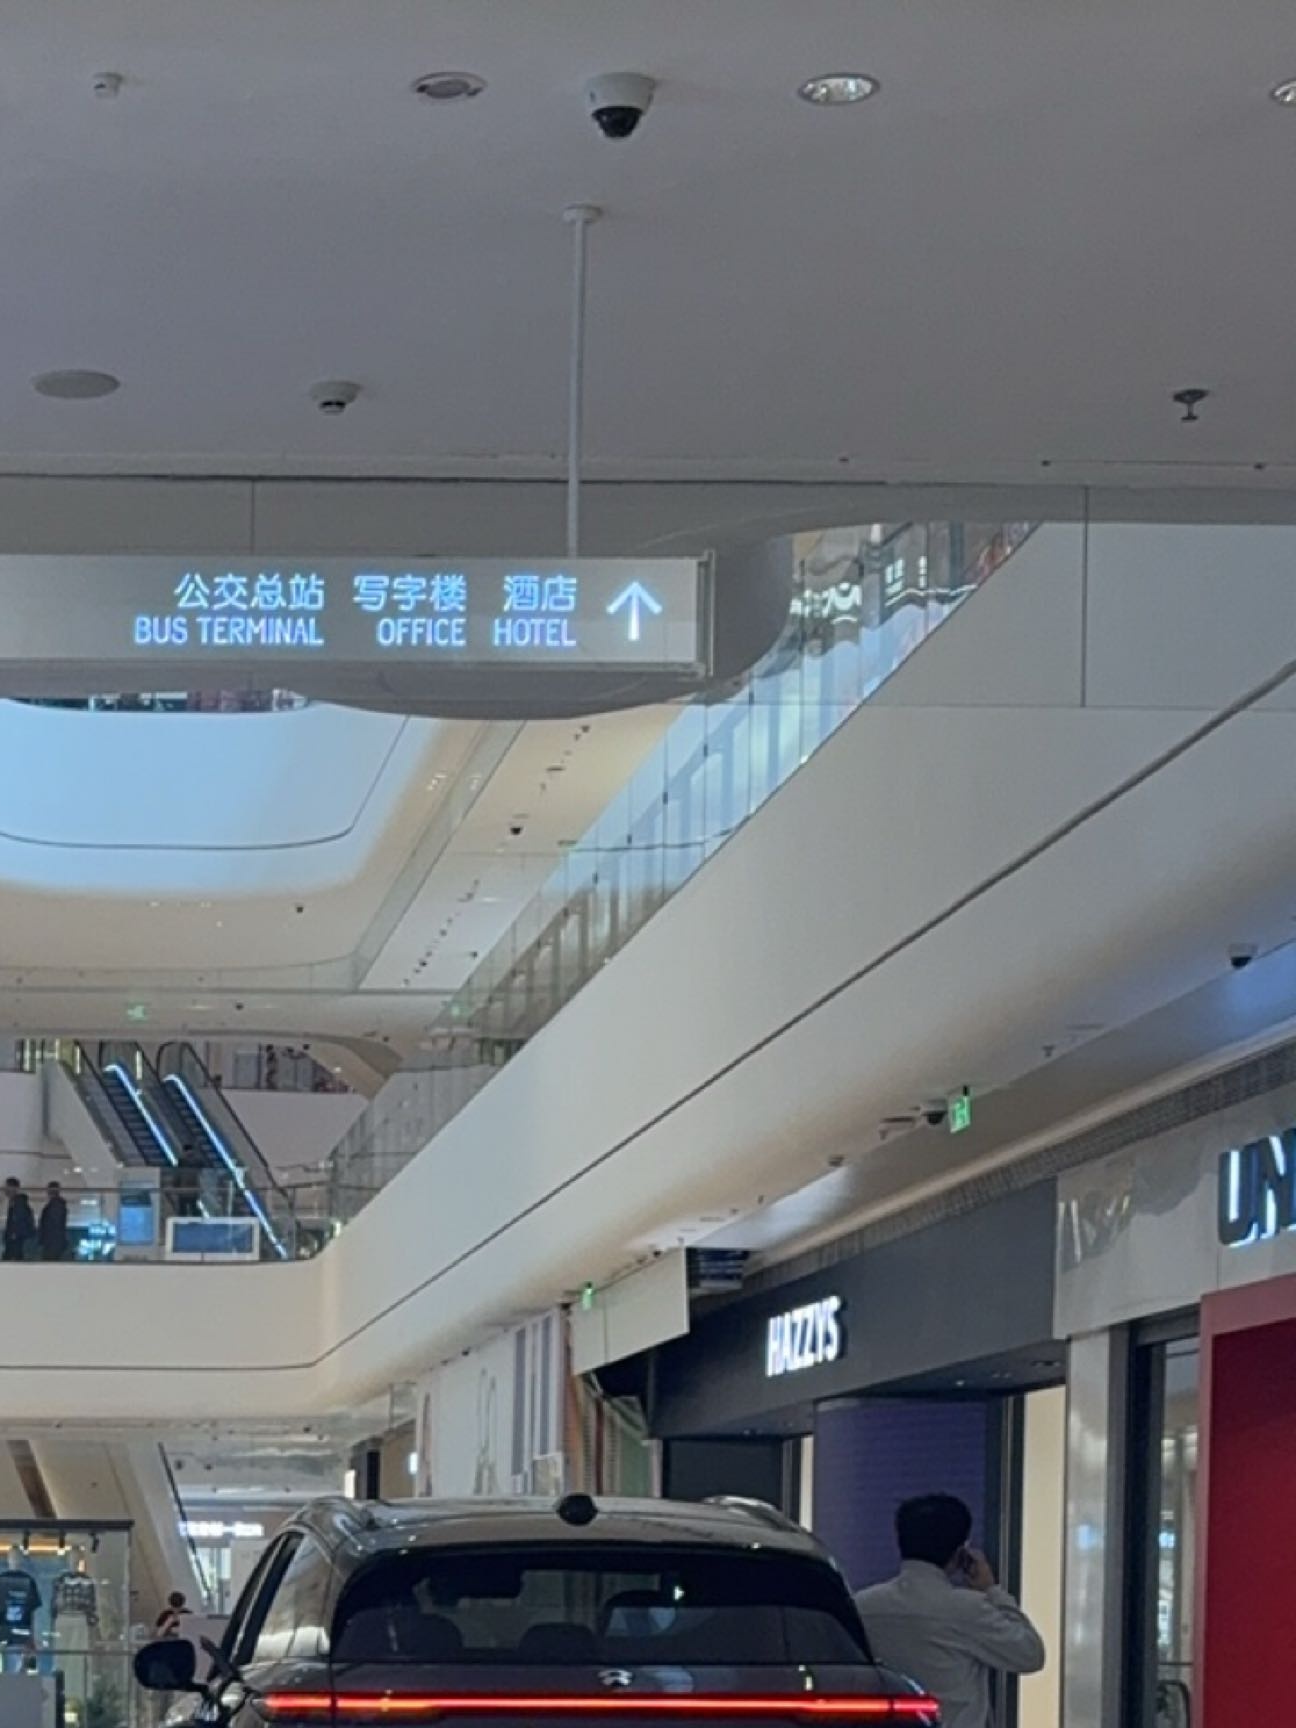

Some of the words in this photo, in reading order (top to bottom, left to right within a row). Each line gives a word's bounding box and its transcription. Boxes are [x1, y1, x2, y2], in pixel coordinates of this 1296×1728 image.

[173, 573, 325, 612] 公交总站
[352, 574, 467, 612] 写字楼
[502, 574, 578, 612] 酒店
[133, 616, 188, 645] BUS
[195, 616, 325, 646] TERMINAL
[376, 617, 467, 647] OFFICE
[492, 617, 578, 647] HOTEL
[766, 1295, 842, 1378] HAZZYS
